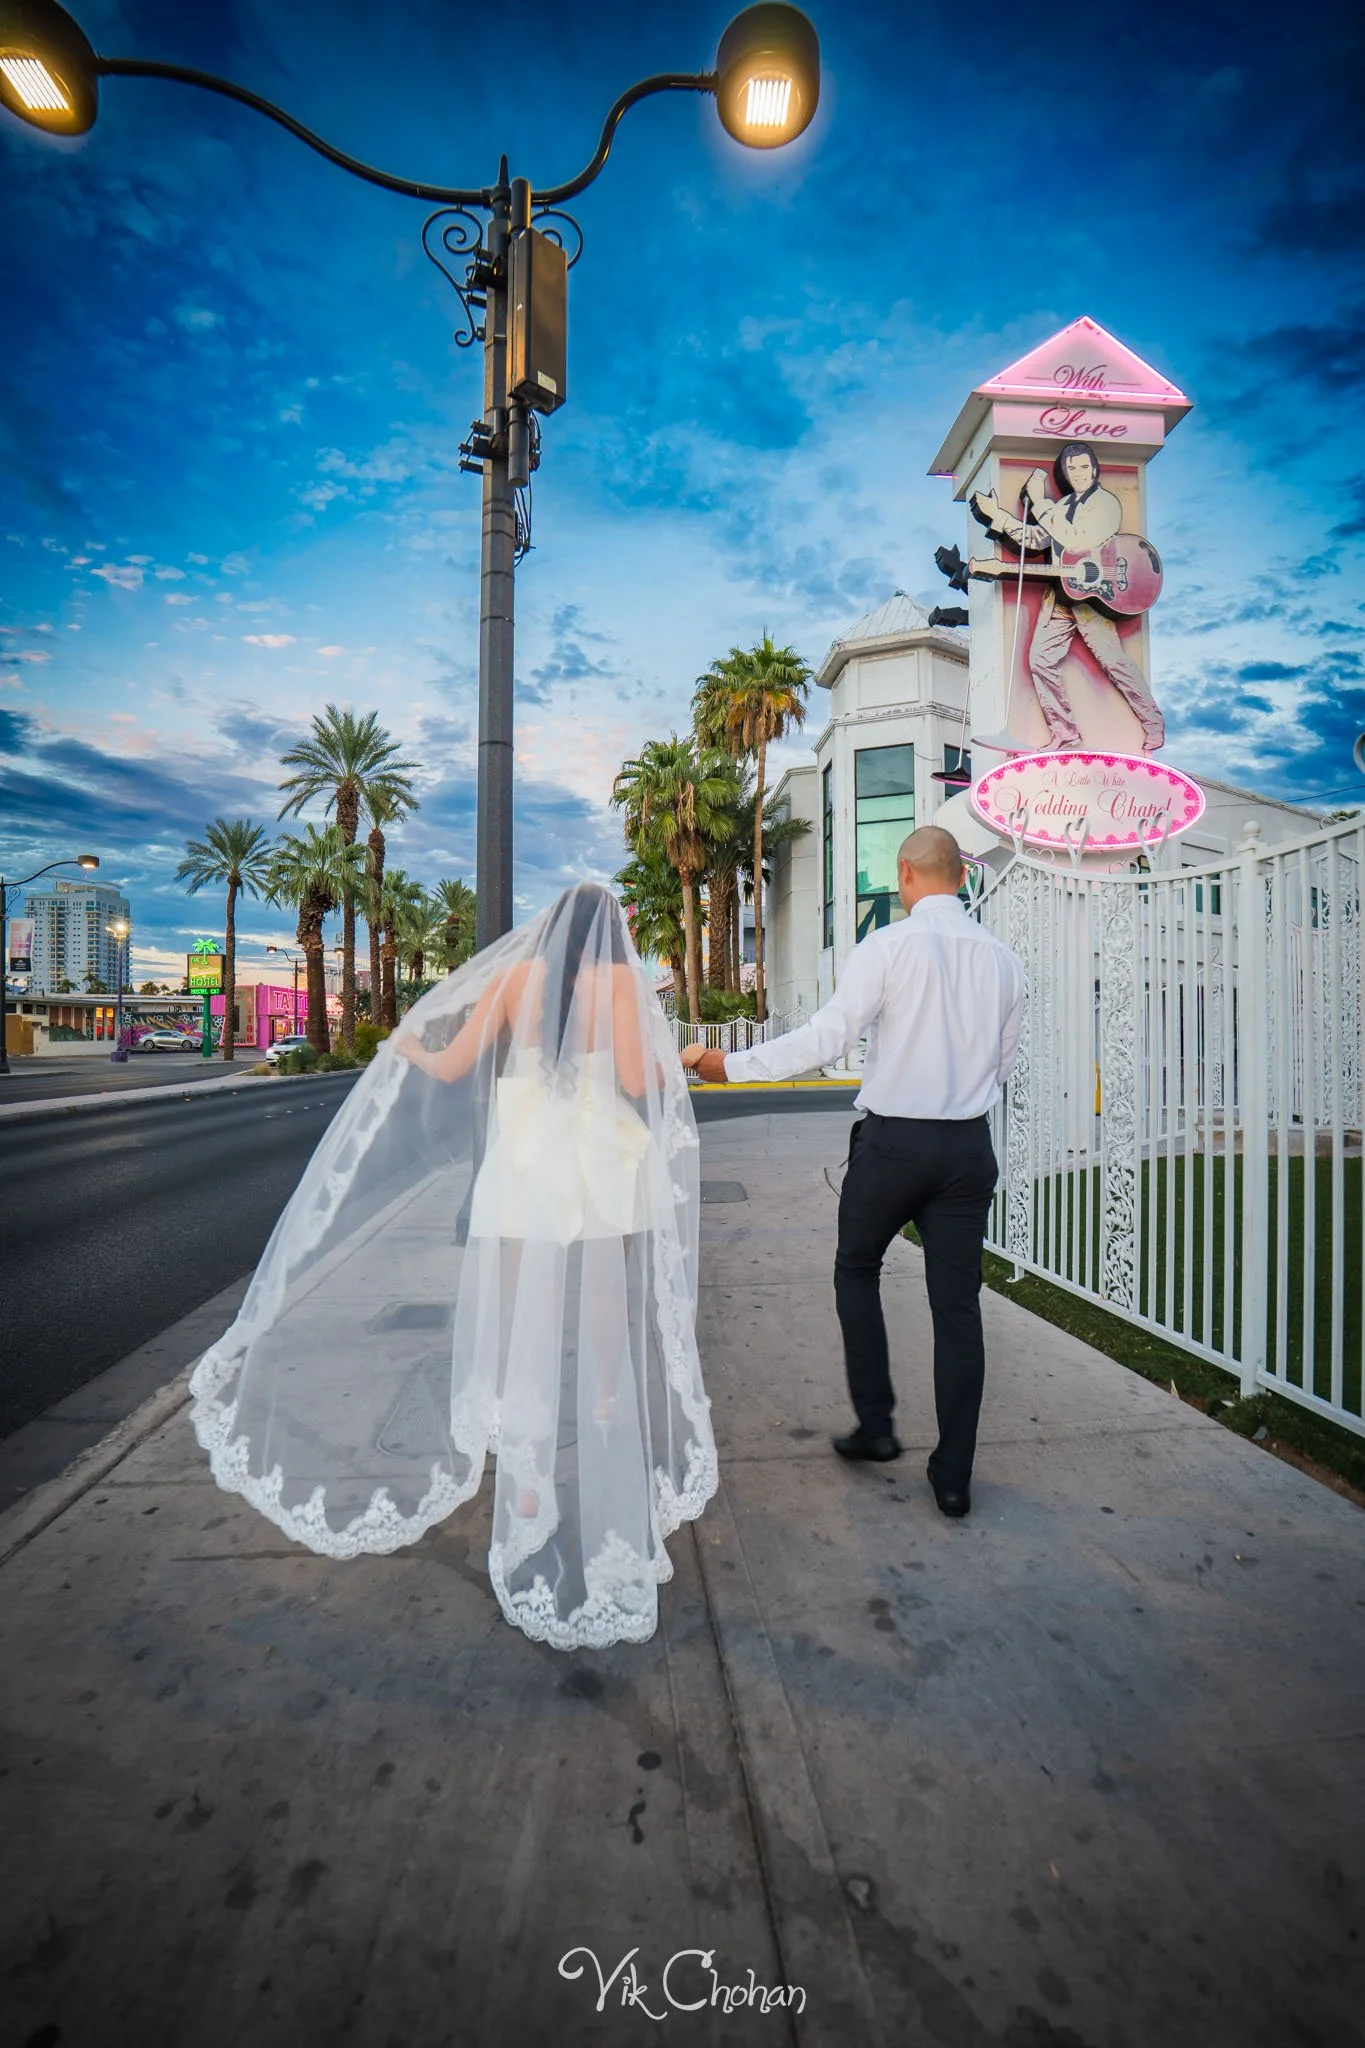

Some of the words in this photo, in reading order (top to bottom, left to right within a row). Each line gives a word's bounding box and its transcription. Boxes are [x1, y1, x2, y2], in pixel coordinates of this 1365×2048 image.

[1053, 364, 1108, 390] With
[1032, 404, 1128, 438] Love
[1094, 771, 1126, 787] White
[190, 977, 219, 986] HOSTEL
